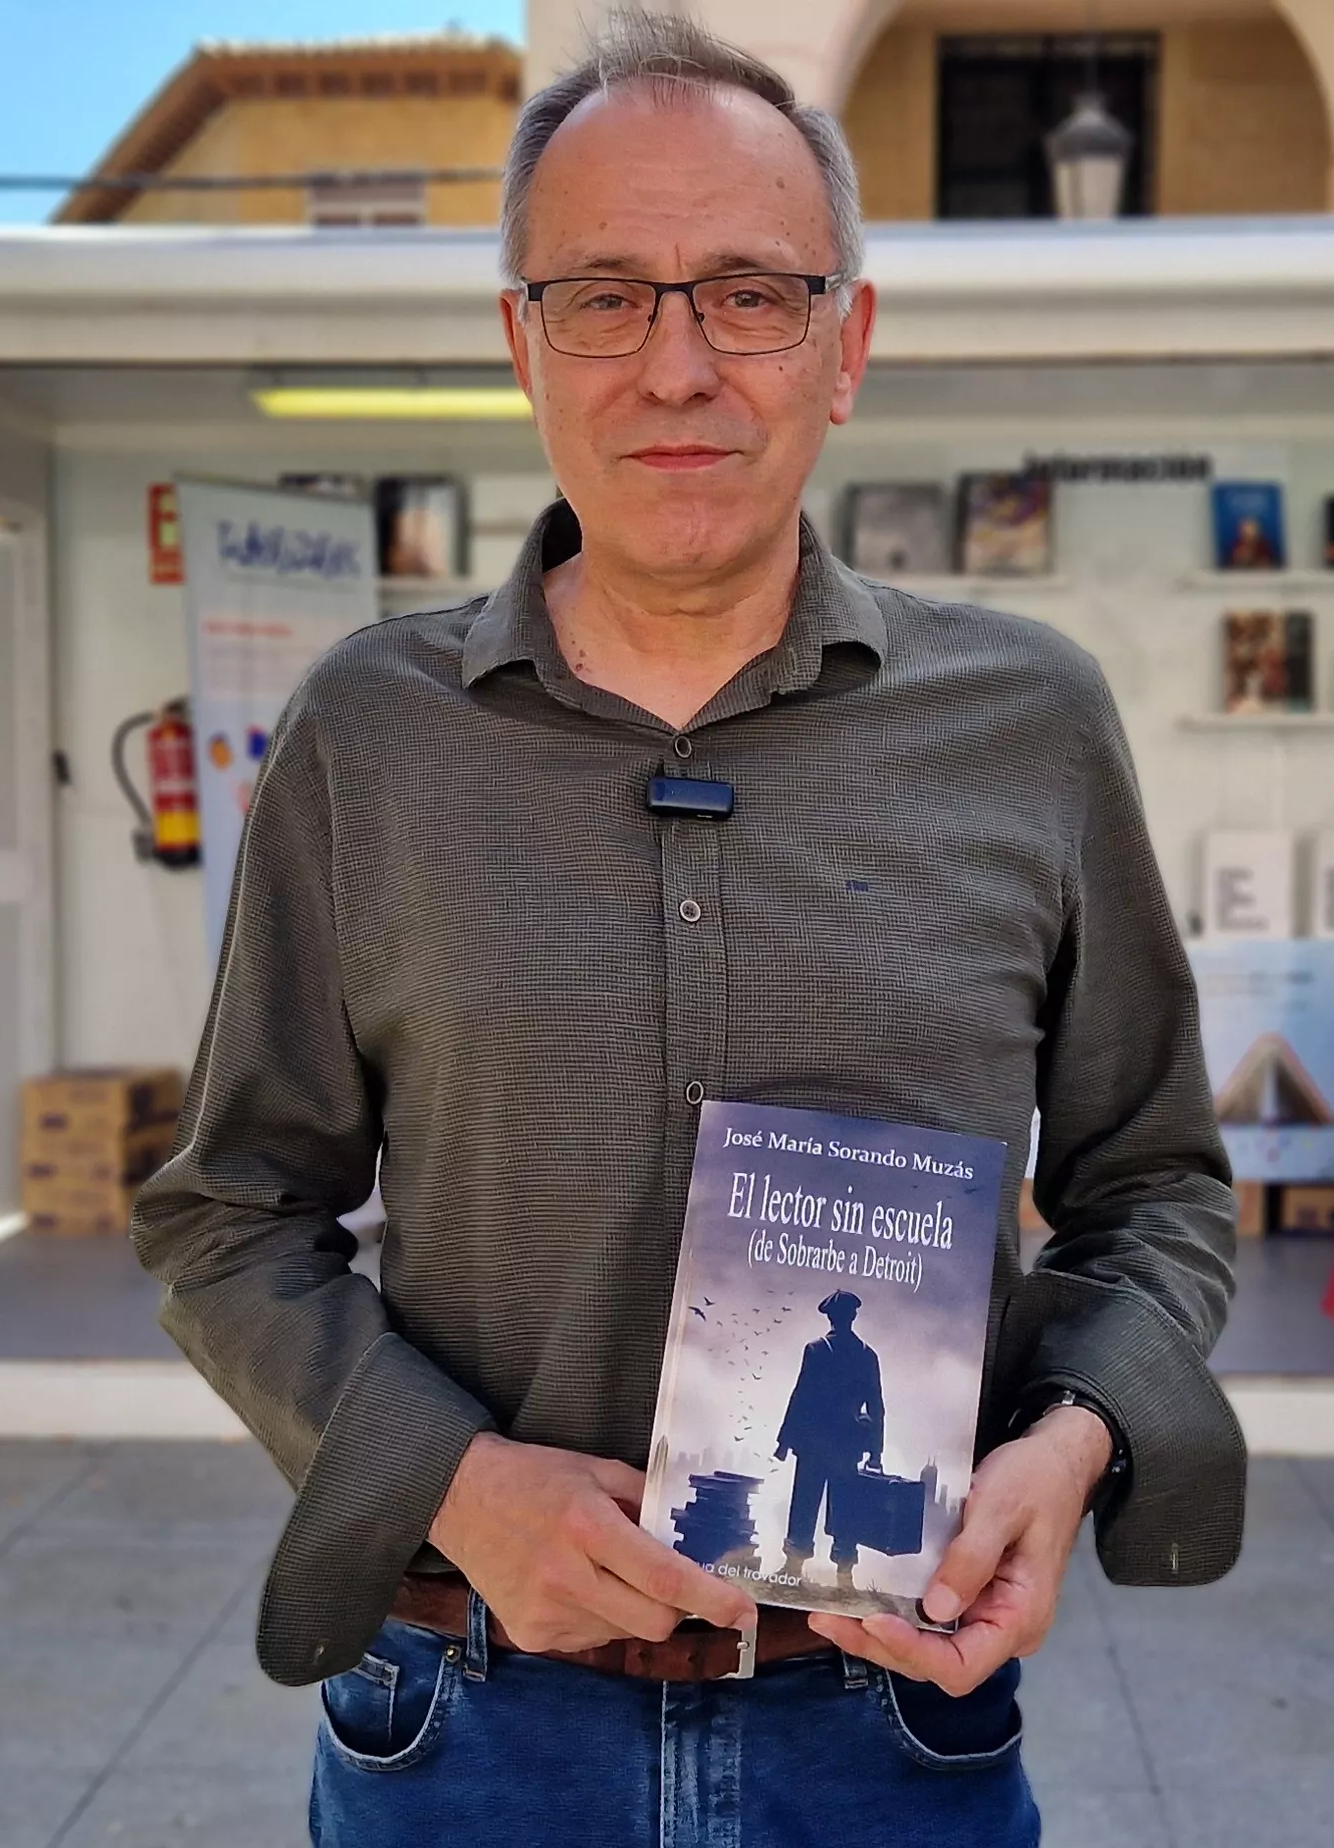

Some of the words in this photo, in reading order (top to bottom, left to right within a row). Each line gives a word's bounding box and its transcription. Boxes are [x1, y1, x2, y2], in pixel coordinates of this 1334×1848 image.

[723, 1127, 763, 1148] José
[767, 1131, 823, 1156] María
[828, 1141, 907, 1168] Sorando
[912, 1152, 974, 1180] Muzás
[727, 1172, 756, 1219] El
[759, 1174, 827, 1229] lector
[831, 1185, 866, 1235] sin
[871, 1200, 954, 1250] escuela
[747, 1228, 774, 1268] (de
[777, 1232, 845, 1273] Sobrarbe
[849, 1252, 858, 1275] a
[862, 1245, 923, 1293] Detroit)
[718, 1562, 740, 1577] del
[744, 1567, 803, 1587] trovador
